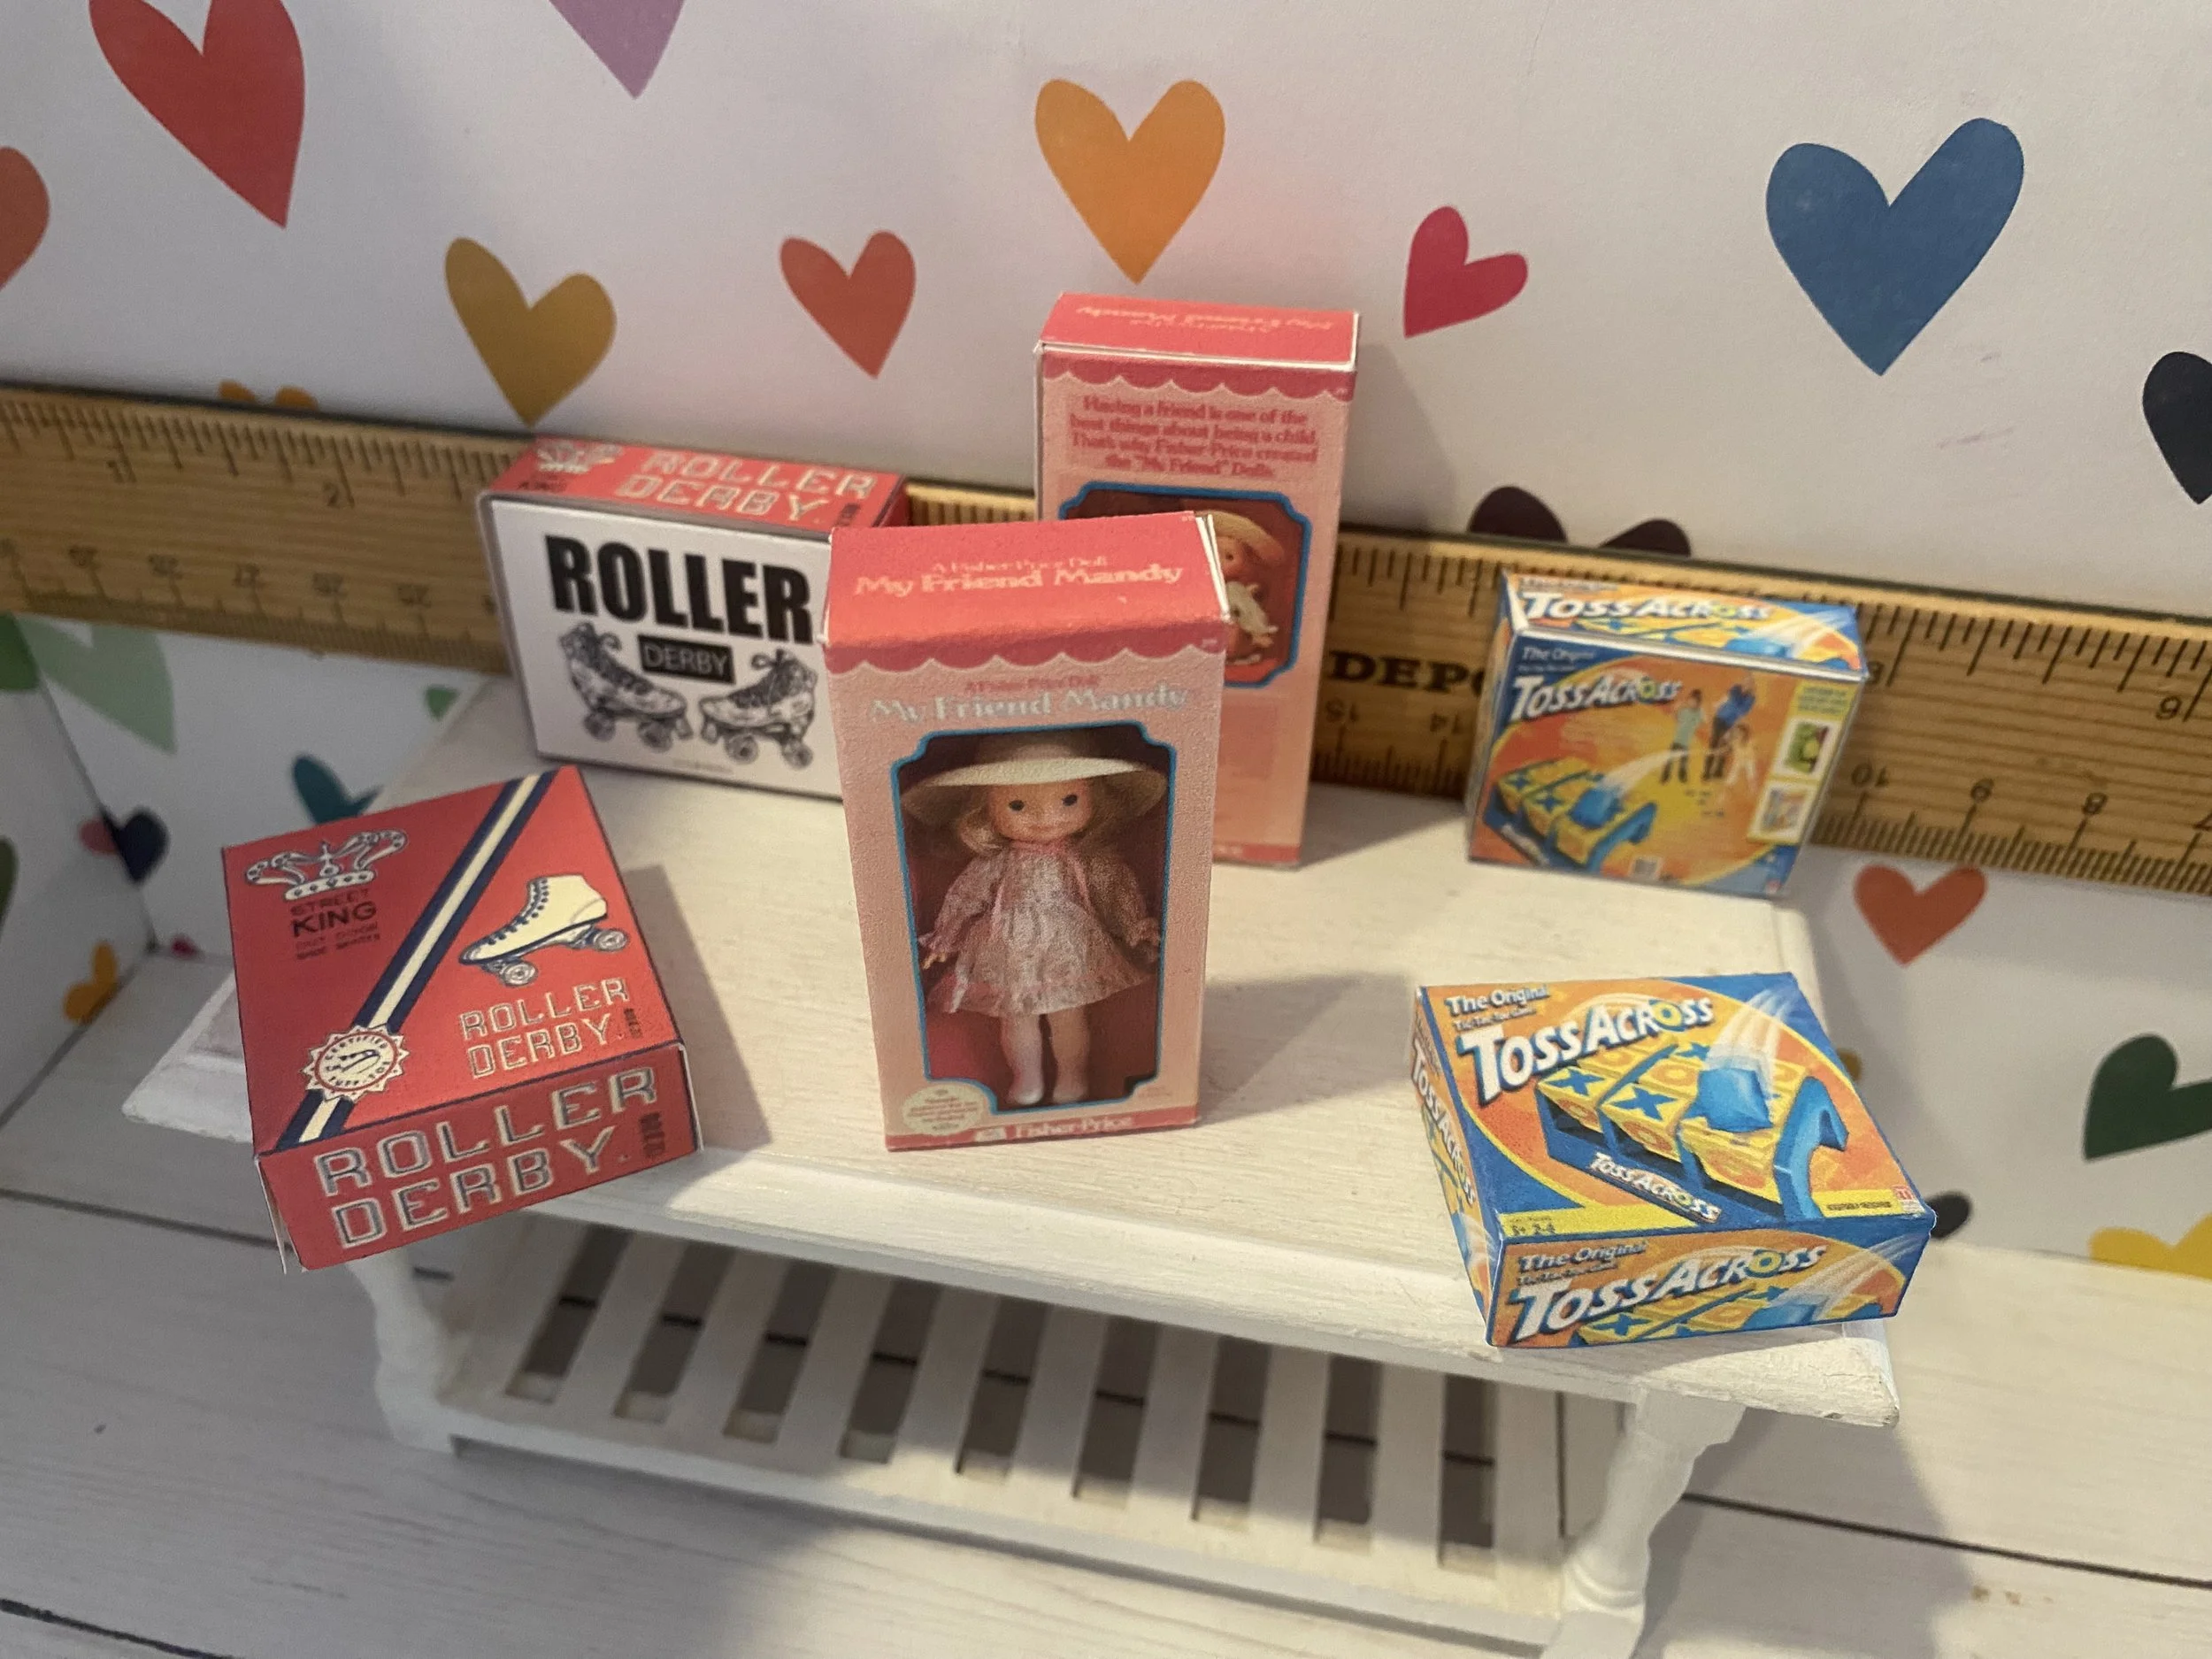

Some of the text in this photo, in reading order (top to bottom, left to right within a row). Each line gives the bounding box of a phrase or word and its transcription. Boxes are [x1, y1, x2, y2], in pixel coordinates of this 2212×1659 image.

[1259, 409, 1278, 424] of
[1281, 410, 1309, 425] the
[641, 449, 878, 500] ROLLER
[544, 534, 814, 646] ROLLER
[854, 562, 1184, 598] My Friend Mandy
[644, 640, 730, 673] DERBY
[933, 692, 1052, 720] Friend
[291, 900, 378, 938] KING
[459, 977, 630, 1041] ROLLER
[1444, 983, 1551, 1017] The Original
[313, 1065, 658, 1198] ROLLER
[1517, 1254, 1571, 1273] The
[1571, 1240, 1649, 1264] Original
